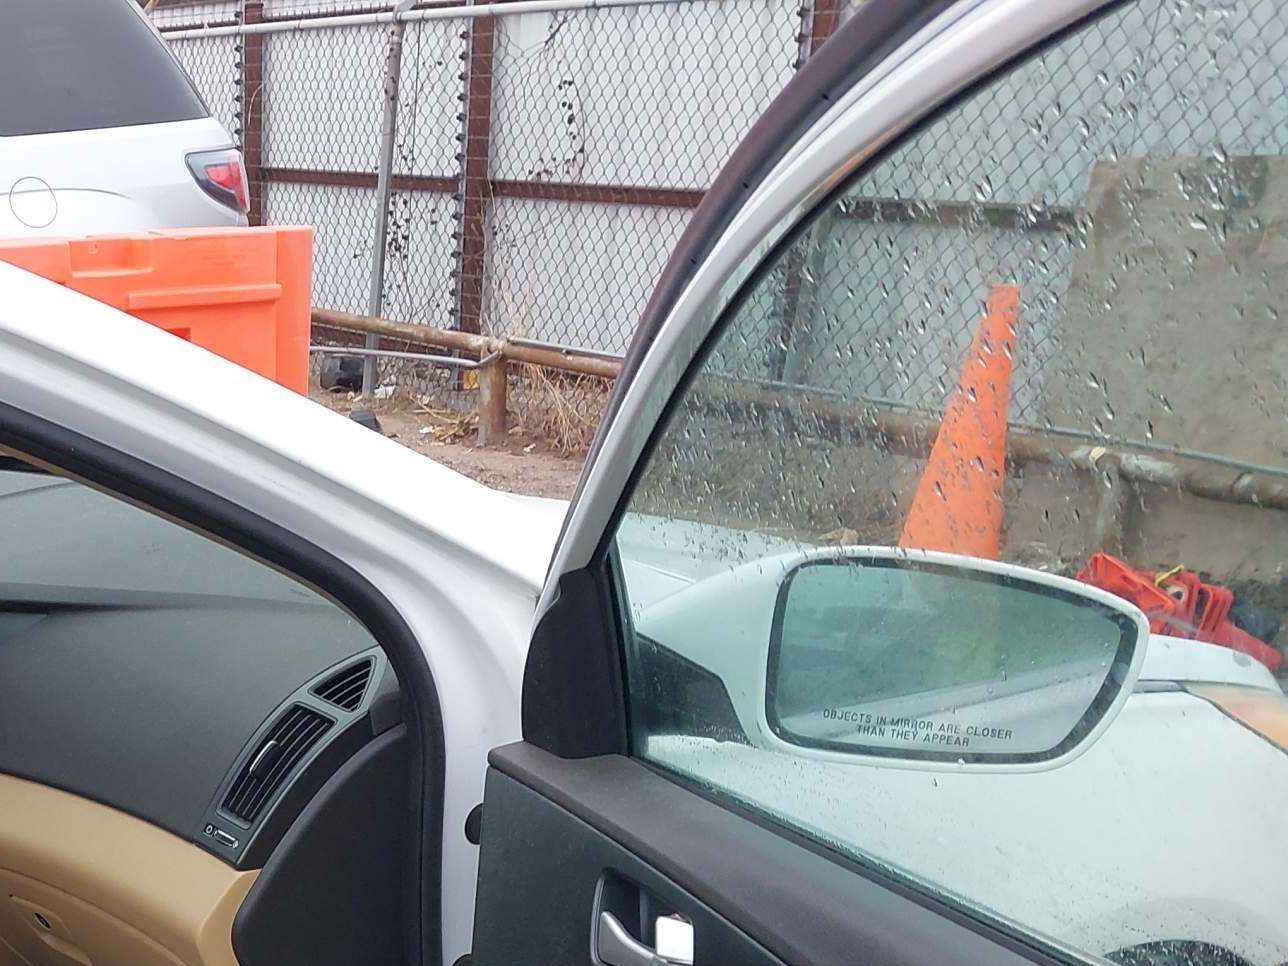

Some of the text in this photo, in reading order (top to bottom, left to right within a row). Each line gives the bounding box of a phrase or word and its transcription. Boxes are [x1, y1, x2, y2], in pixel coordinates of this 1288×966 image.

[823, 708, 1013, 741] OBJECTS IN MIRROR ARE CLOSER
[856, 724, 970, 748] THAN THEY APPEAR
